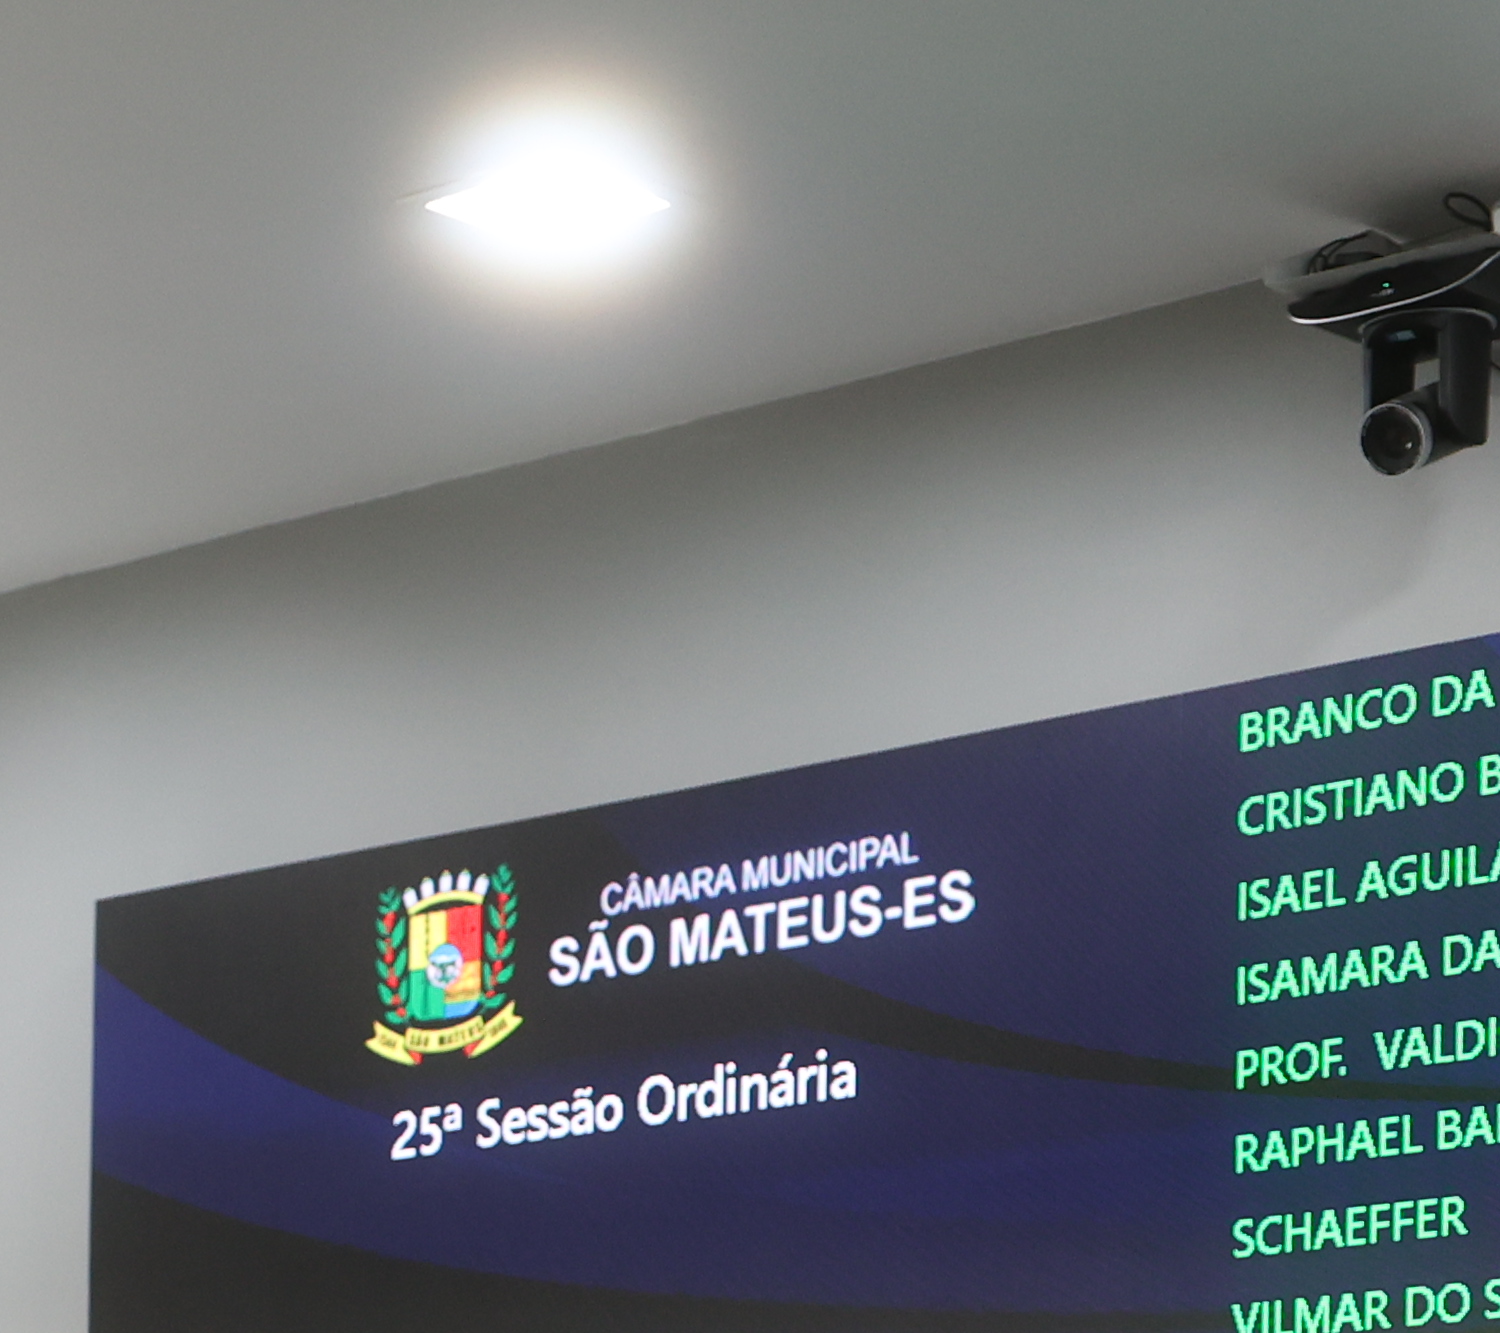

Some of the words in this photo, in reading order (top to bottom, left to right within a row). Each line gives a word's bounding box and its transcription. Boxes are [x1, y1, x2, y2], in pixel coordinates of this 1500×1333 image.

[1239, 683, 1418, 753] BRANCO
[1432, 669, 1496, 718] DA
[1237, 761, 1465, 836] CRISTIANO
[599, 869, 738, 920] CÂMARA
[740, 832, 920, 893] MUNICIPAL
[1238, 867, 1347, 921] ISAEL
[548, 919, 655, 987] SÃO
[665, 869, 976, 967] MATEUS-ES
[1237, 940, 1430, 1006] ISAMARA
[1236, 1037, 1347, 1090] PROF.
[390, 1102, 463, 1161] 25ª
[476, 1086, 624, 1149] Sessão
[637, 1048, 857, 1126] Ordinária
[1235, 1114, 1424, 1174] RAPHAEL
[1232, 1195, 1469, 1259] SCHAEFFER
[1405, 1282, 1471, 1327] DO
